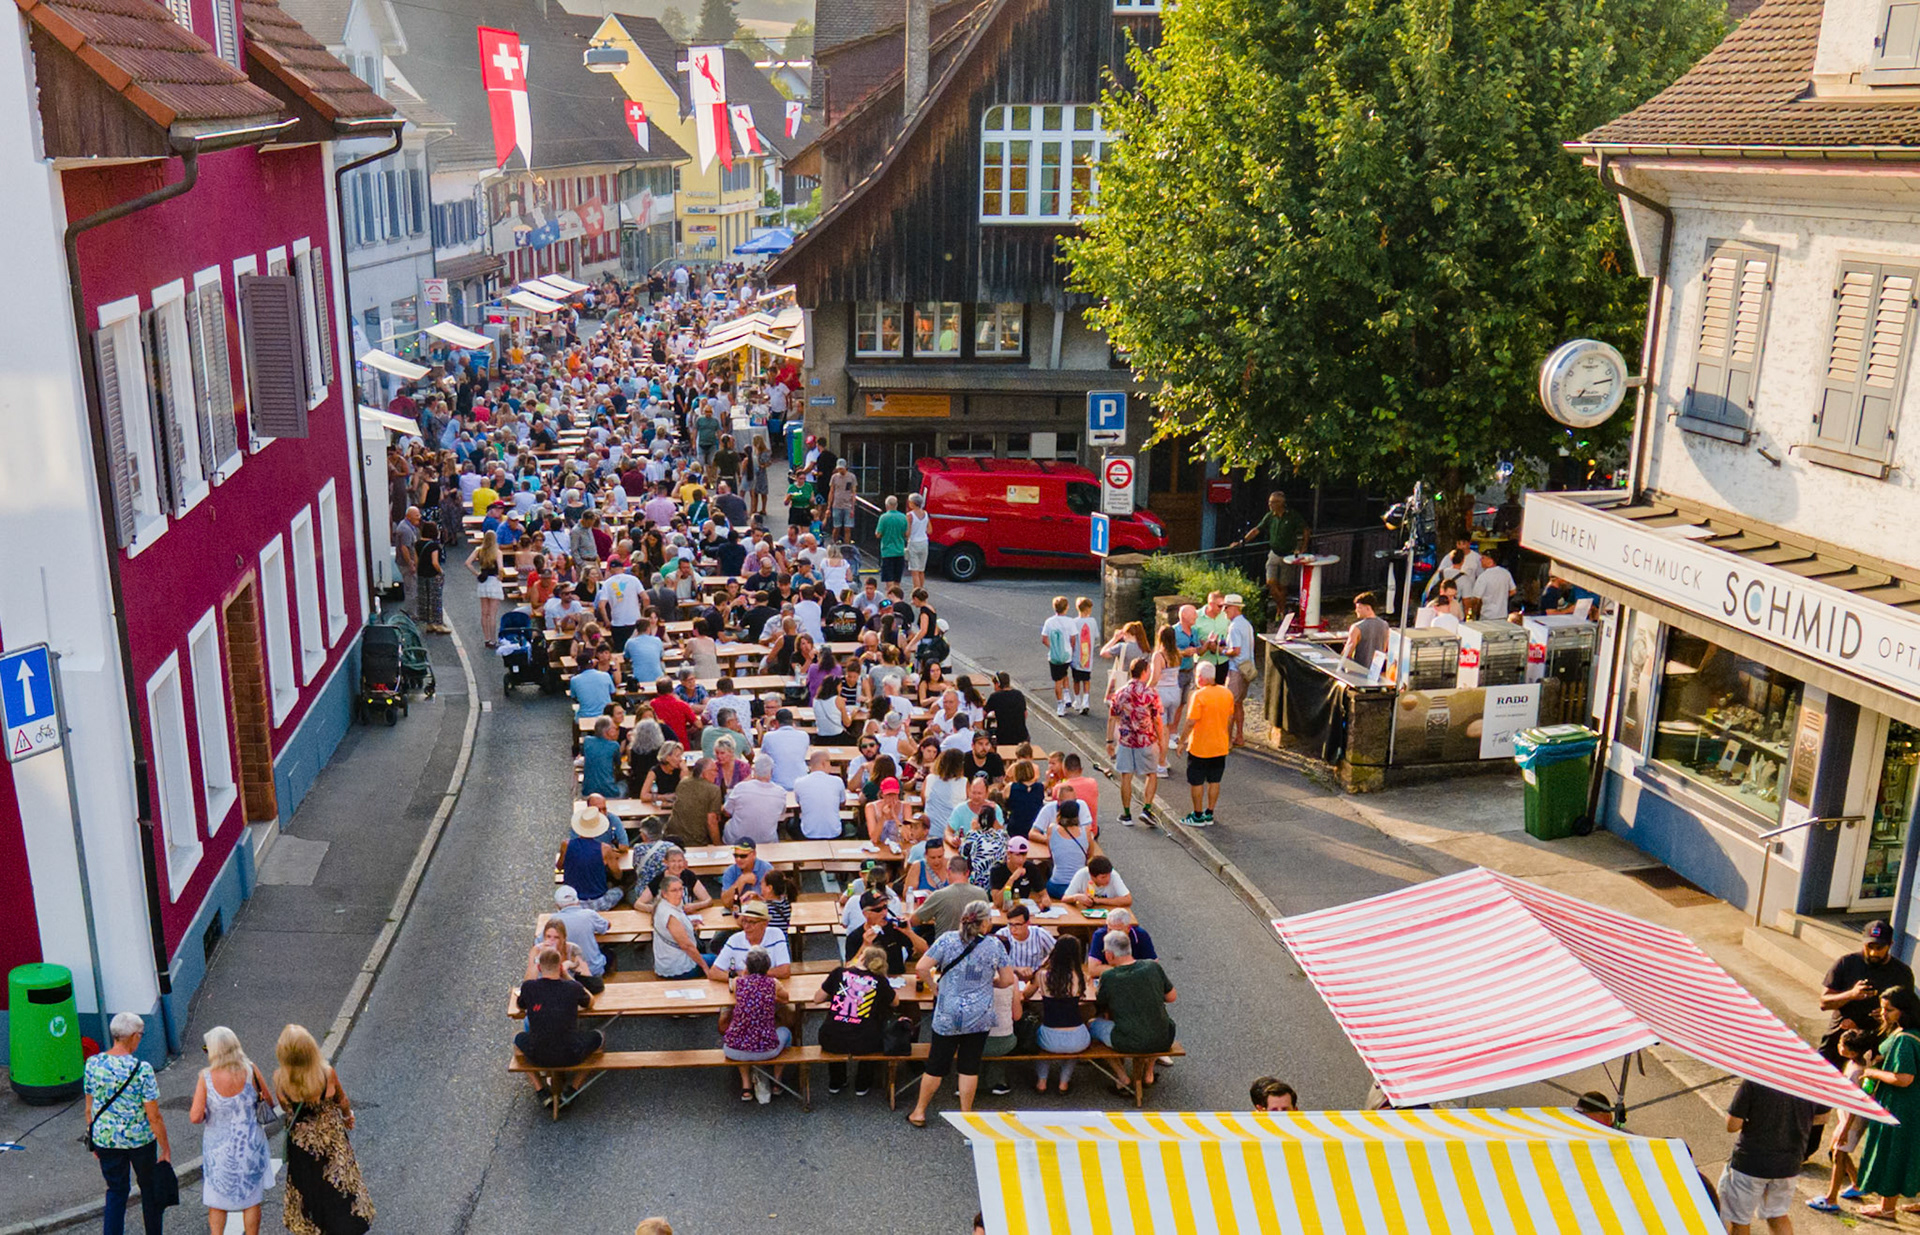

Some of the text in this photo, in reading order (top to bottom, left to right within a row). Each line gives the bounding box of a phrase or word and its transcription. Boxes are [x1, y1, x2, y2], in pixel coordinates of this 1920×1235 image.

[1099, 399, 1117, 426] P
[365, 454, 372, 466] 5
[1551, 518, 1703, 590] UHREN SCHMUCK
[1722, 571, 1863, 660] SCHMID
[1496, 695, 1529, 705] RADO
